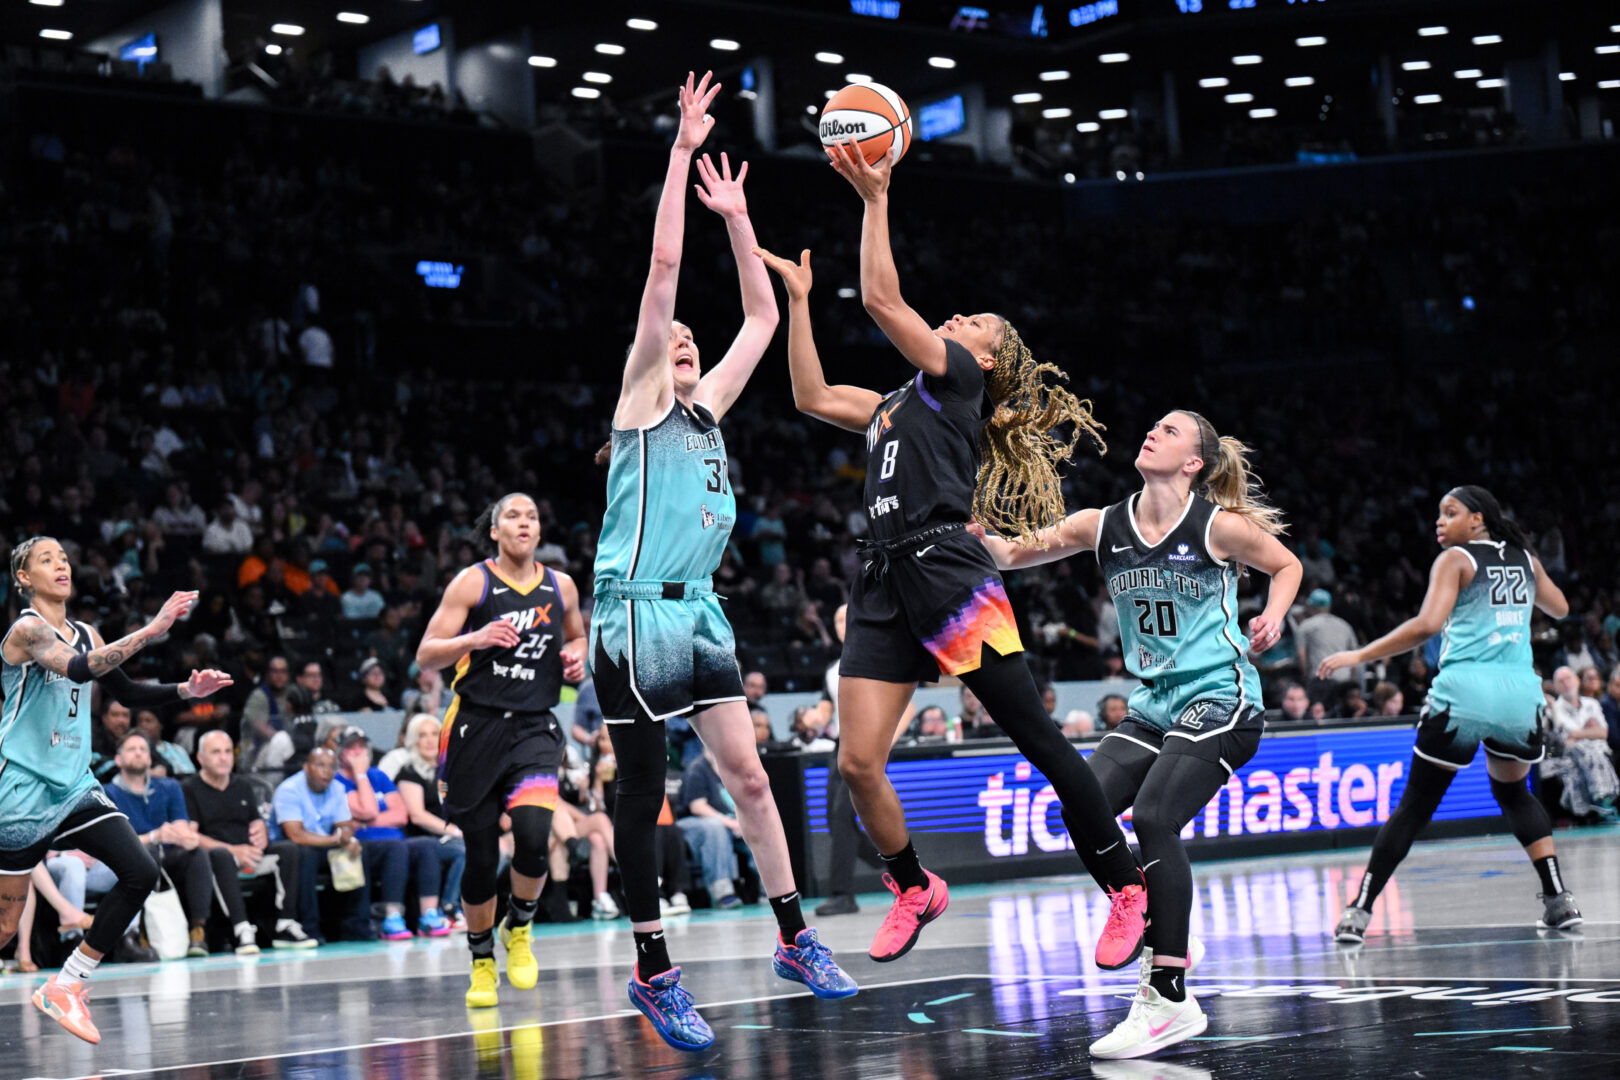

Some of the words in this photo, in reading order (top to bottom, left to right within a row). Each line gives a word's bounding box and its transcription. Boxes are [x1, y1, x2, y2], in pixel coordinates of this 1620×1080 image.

[821, 119, 867, 138] Wilson
[880, 440, 899, 480] 8
[1486, 566, 1529, 608] 22
[1133, 598, 1178, 637] 20
[514, 633, 553, 659] 25
[68, 687, 80, 719] 9
